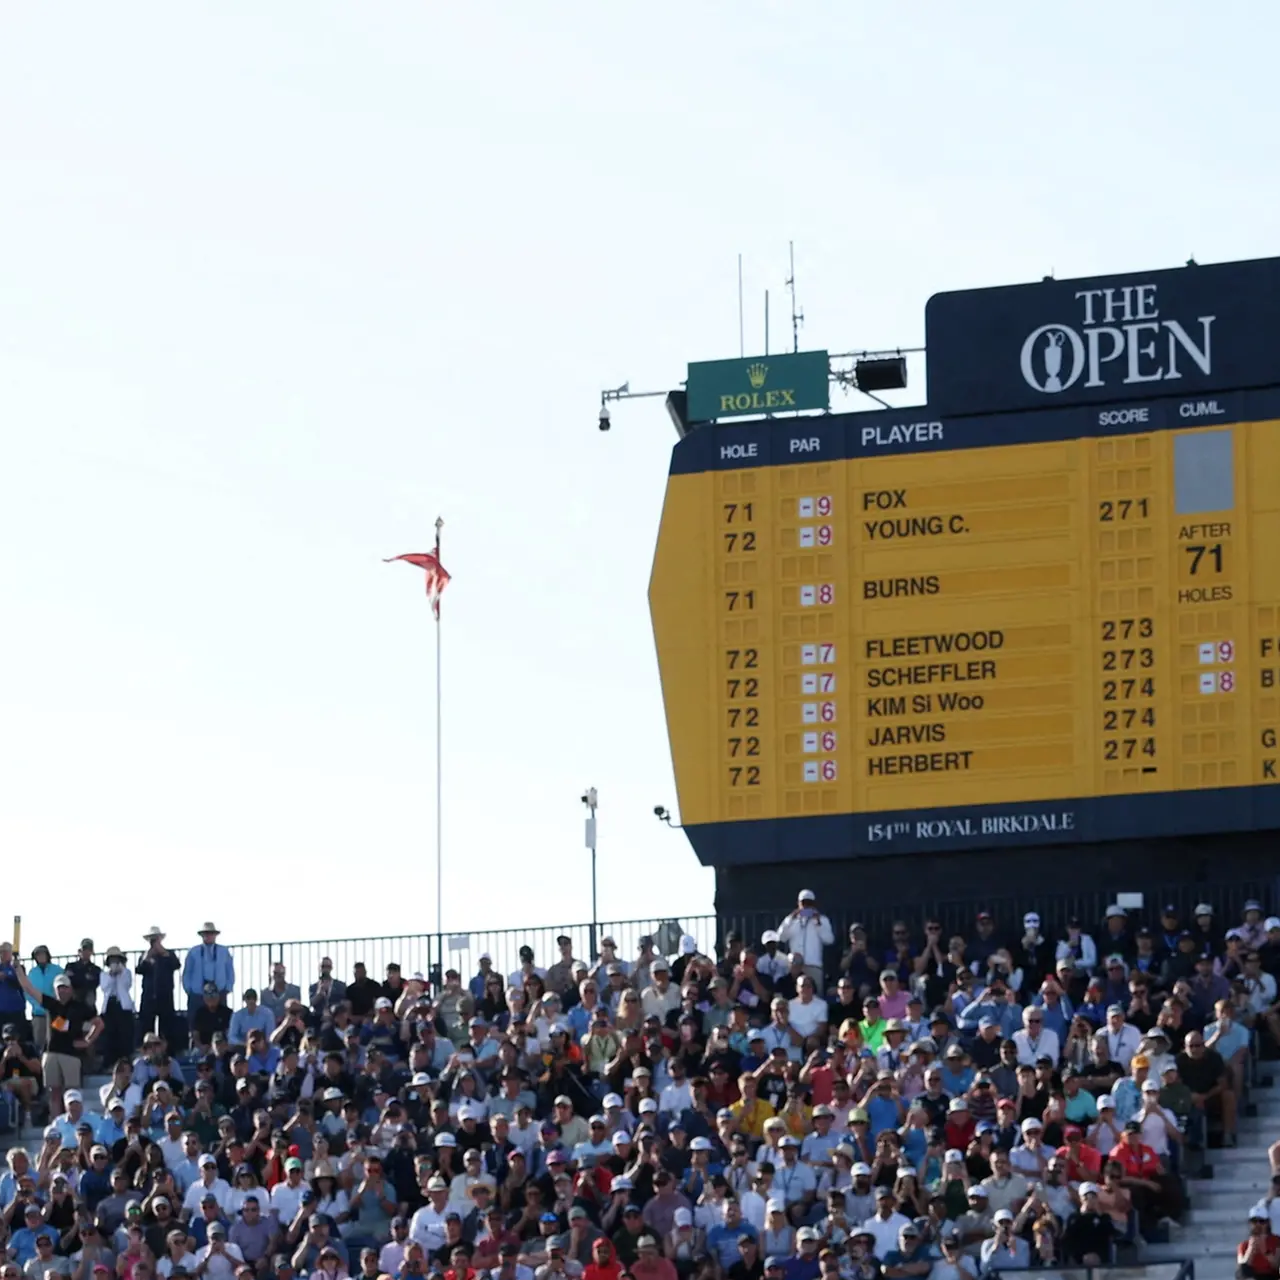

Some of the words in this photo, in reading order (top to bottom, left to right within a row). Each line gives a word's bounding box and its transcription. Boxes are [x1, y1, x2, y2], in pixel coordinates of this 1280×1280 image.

[1075, 285, 1158, 324] THE
[1020, 315, 1216, 393] OPEN
[721, 390, 795, 411] ROLEX
[721, 444, 757, 459] HOLE
[790, 438, 820, 453] PAR
[862, 422, 943, 445] PLAYER
[1099, 408, 1148, 425] SCORE
[724, 503, 752, 523] 71
[864, 490, 906, 510] FOX
[725, 532, 756, 552] 72
[865, 516, 943, 540] YOUNG
[949, 515, 969, 533] C.
[1100, 498, 1147, 521] 271
[1179, 523, 1230, 539] AFTER
[1186, 544, 1222, 575] 71
[726, 591, 753, 611] 71
[864, 576, 940, 599] BURNS
[1178, 586, 1232, 603] HOLES
[727, 649, 757, 669] 72
[866, 631, 1003, 658] FLEETWOOD
[1102, 618, 1152, 640] 273
[727, 678, 758, 698] 72
[868, 661, 996, 687] SCHEFFLER
[1103, 648, 1153, 670] 273
[728, 708, 758, 727] 72
[868, 697, 905, 716] KIM
[913, 695, 931, 713] Si
[938, 693, 984, 711] Woo
[1104, 678, 1154, 700] 274
[728, 737, 759, 757] 72
[868, 724, 945, 746] JARVIS
[1104, 708, 1155, 730] 274
[729, 766, 760, 786] 72
[868, 751, 973, 775] HERBERT
[1105, 738, 1155, 760] 274
[917, 820, 976, 839] ROYAL
[982, 812, 1075, 834] BIRKDALE
